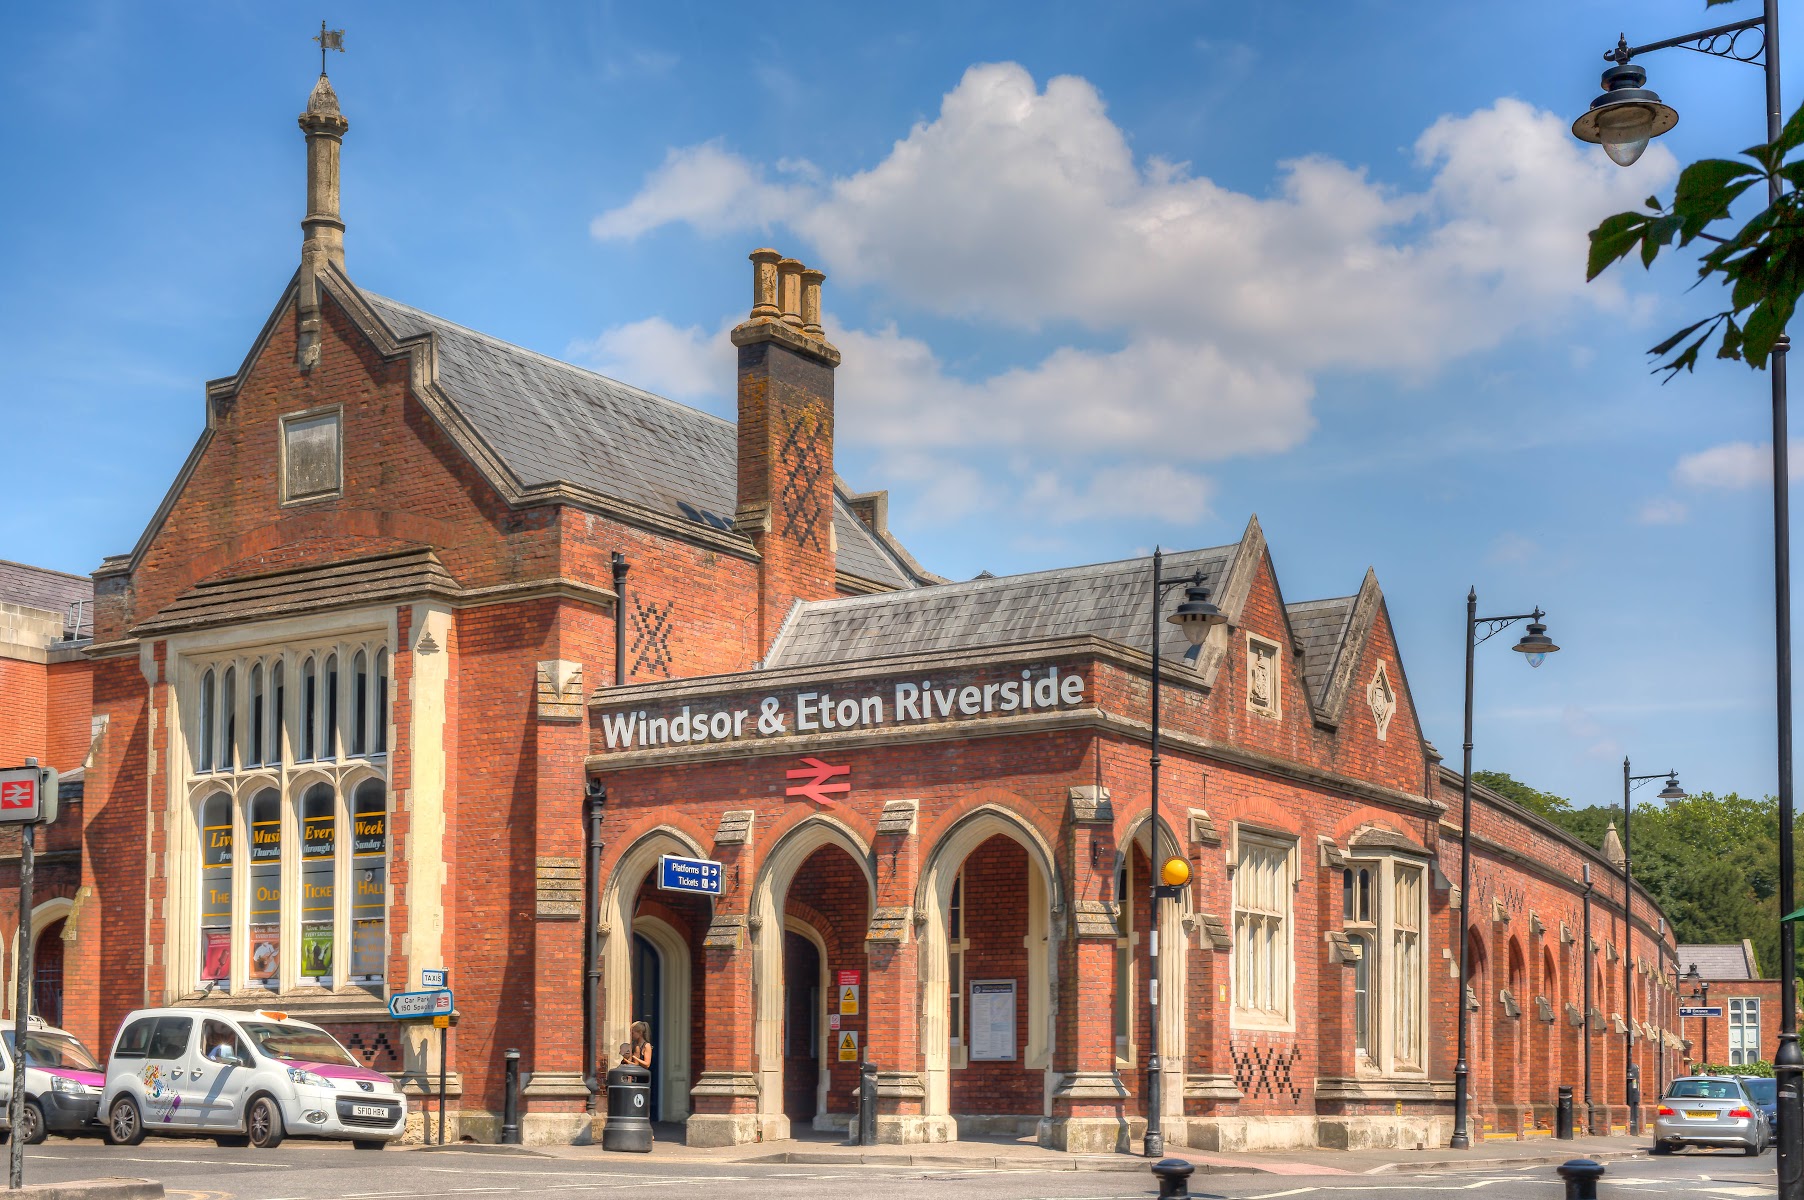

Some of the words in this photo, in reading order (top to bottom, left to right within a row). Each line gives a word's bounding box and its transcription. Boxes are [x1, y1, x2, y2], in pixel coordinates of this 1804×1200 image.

[602, 705, 749, 749] Windsor
[757, 696, 786, 735] &
[797, 691, 884, 731] Eton
[895, 666, 1085, 722] Riverside
[253, 828, 281, 844] Musi
[304, 825, 335, 842] Every
[355, 820, 384, 836] Week
[354, 839, 382, 850] Sunday
[672, 862, 699, 874] Platforms
[678, 876, 699, 887] Tickets
[424, 974, 442, 982] TAXIS
